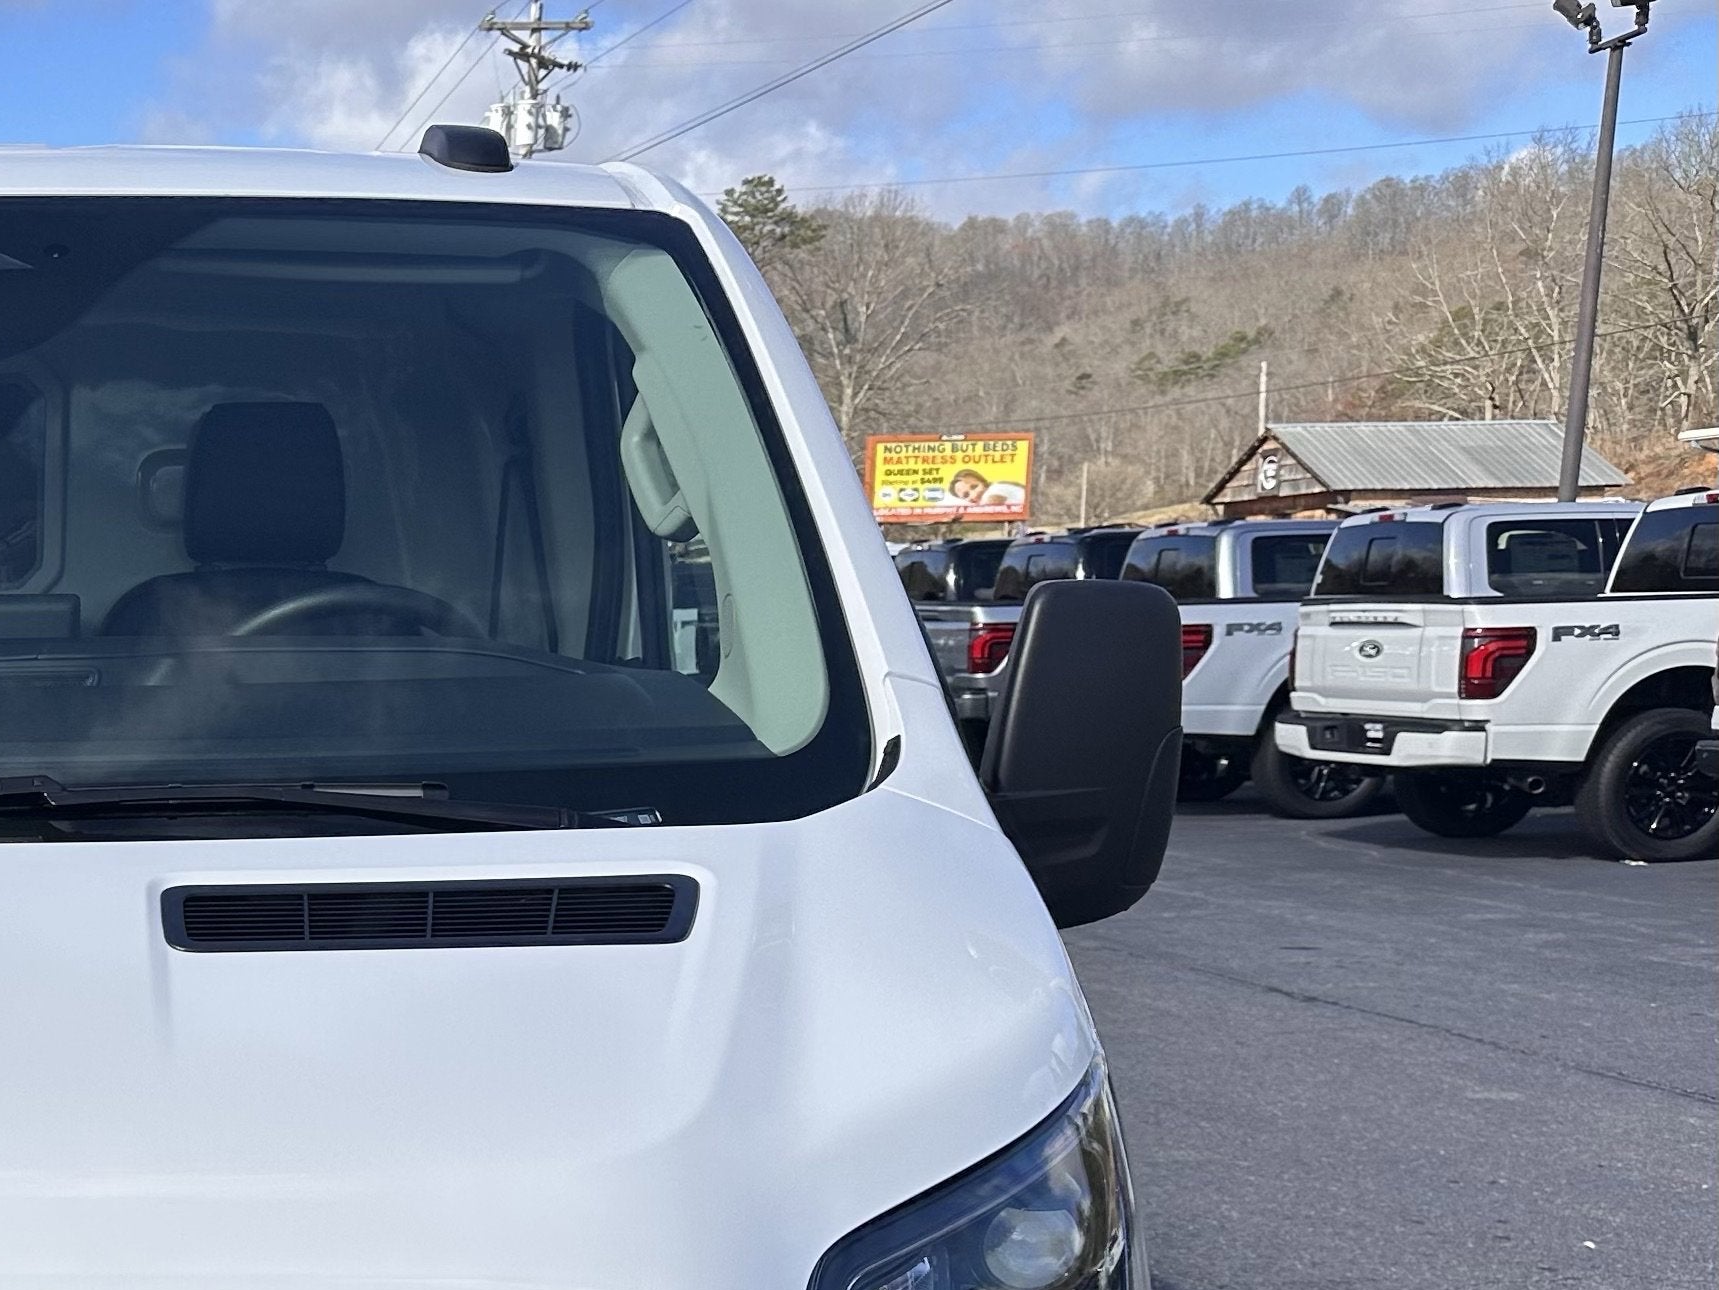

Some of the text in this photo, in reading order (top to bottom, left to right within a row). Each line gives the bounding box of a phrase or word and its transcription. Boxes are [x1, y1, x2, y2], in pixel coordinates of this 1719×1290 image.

[883, 441, 1018, 454] NOTHING BUT BEDS
[883, 453, 1017, 466] MATTRESS OUTLET
[884, 468, 941, 477] QUEEN SET
[1552, 624, 1620, 641] FX4
